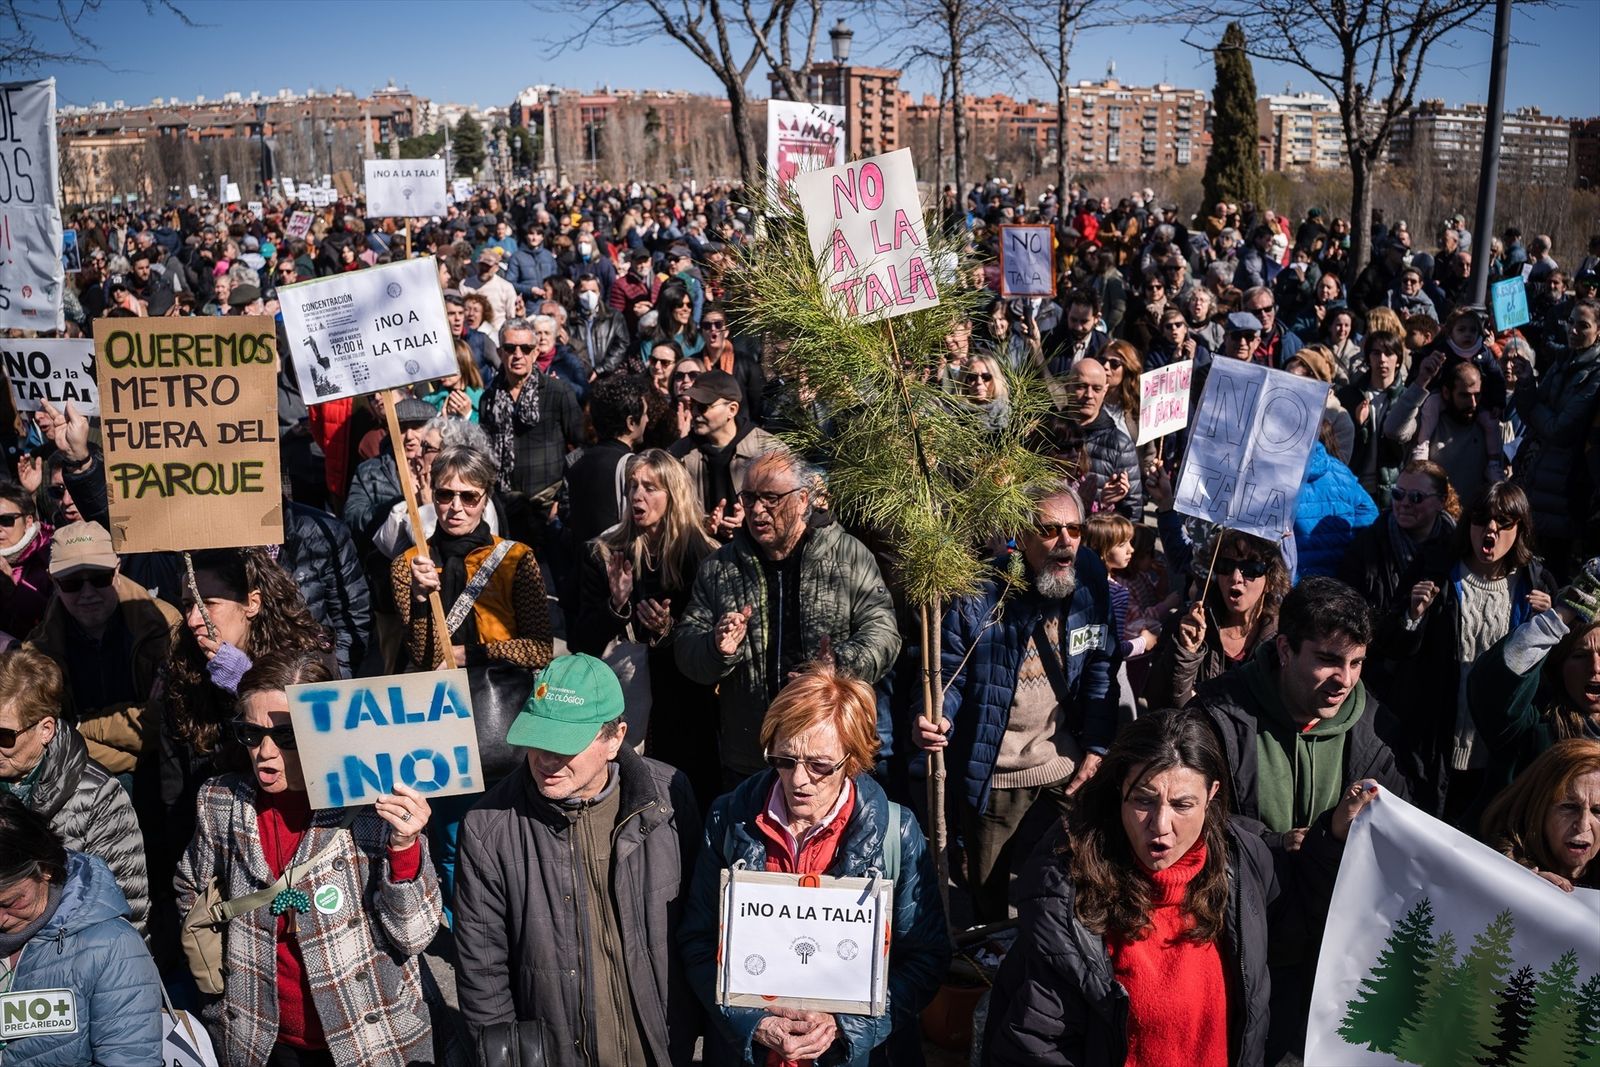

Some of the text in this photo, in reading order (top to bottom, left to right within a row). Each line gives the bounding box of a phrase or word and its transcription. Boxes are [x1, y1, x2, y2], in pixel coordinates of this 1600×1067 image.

[373, 170, 391, 178] ¡NO
[414, 169, 440, 177] TALA!
[832, 162, 885, 220] NO
[832, 209, 921, 273] A LA
[1012, 232, 1042, 254] NO
[830, 256, 936, 317] TALA
[1007, 270, 1043, 286] TALA
[301, 292, 353, 312] CONCENTRACIÓN
[374, 312, 404, 331] ¡NO
[408, 310, 420, 323] A
[104, 330, 276, 369] QUEREMOS
[331, 339, 364, 356] 12:00 H
[372, 331, 438, 356] LA TALA!
[2, 351, 79, 379] NO a la
[11, 379, 81, 402] TALA
[110, 373, 240, 413] METRO
[1207, 375, 1309, 454] NO
[104, 418, 276, 452] FUERA DEL
[1219, 452, 1231, 469] A
[110, 461, 265, 499] PARQUE
[1187, 462, 1286, 533] TALA
[1072, 630, 1103, 647] NO+
[297, 681, 472, 733] TALA
[325, 745, 473, 807] ¡NO!
[740, 902, 872, 923] ¡NO A LA TALA!
[4, 998, 70, 1024] NO+
[4, 1019, 72, 1032] PRECARIEDAD
